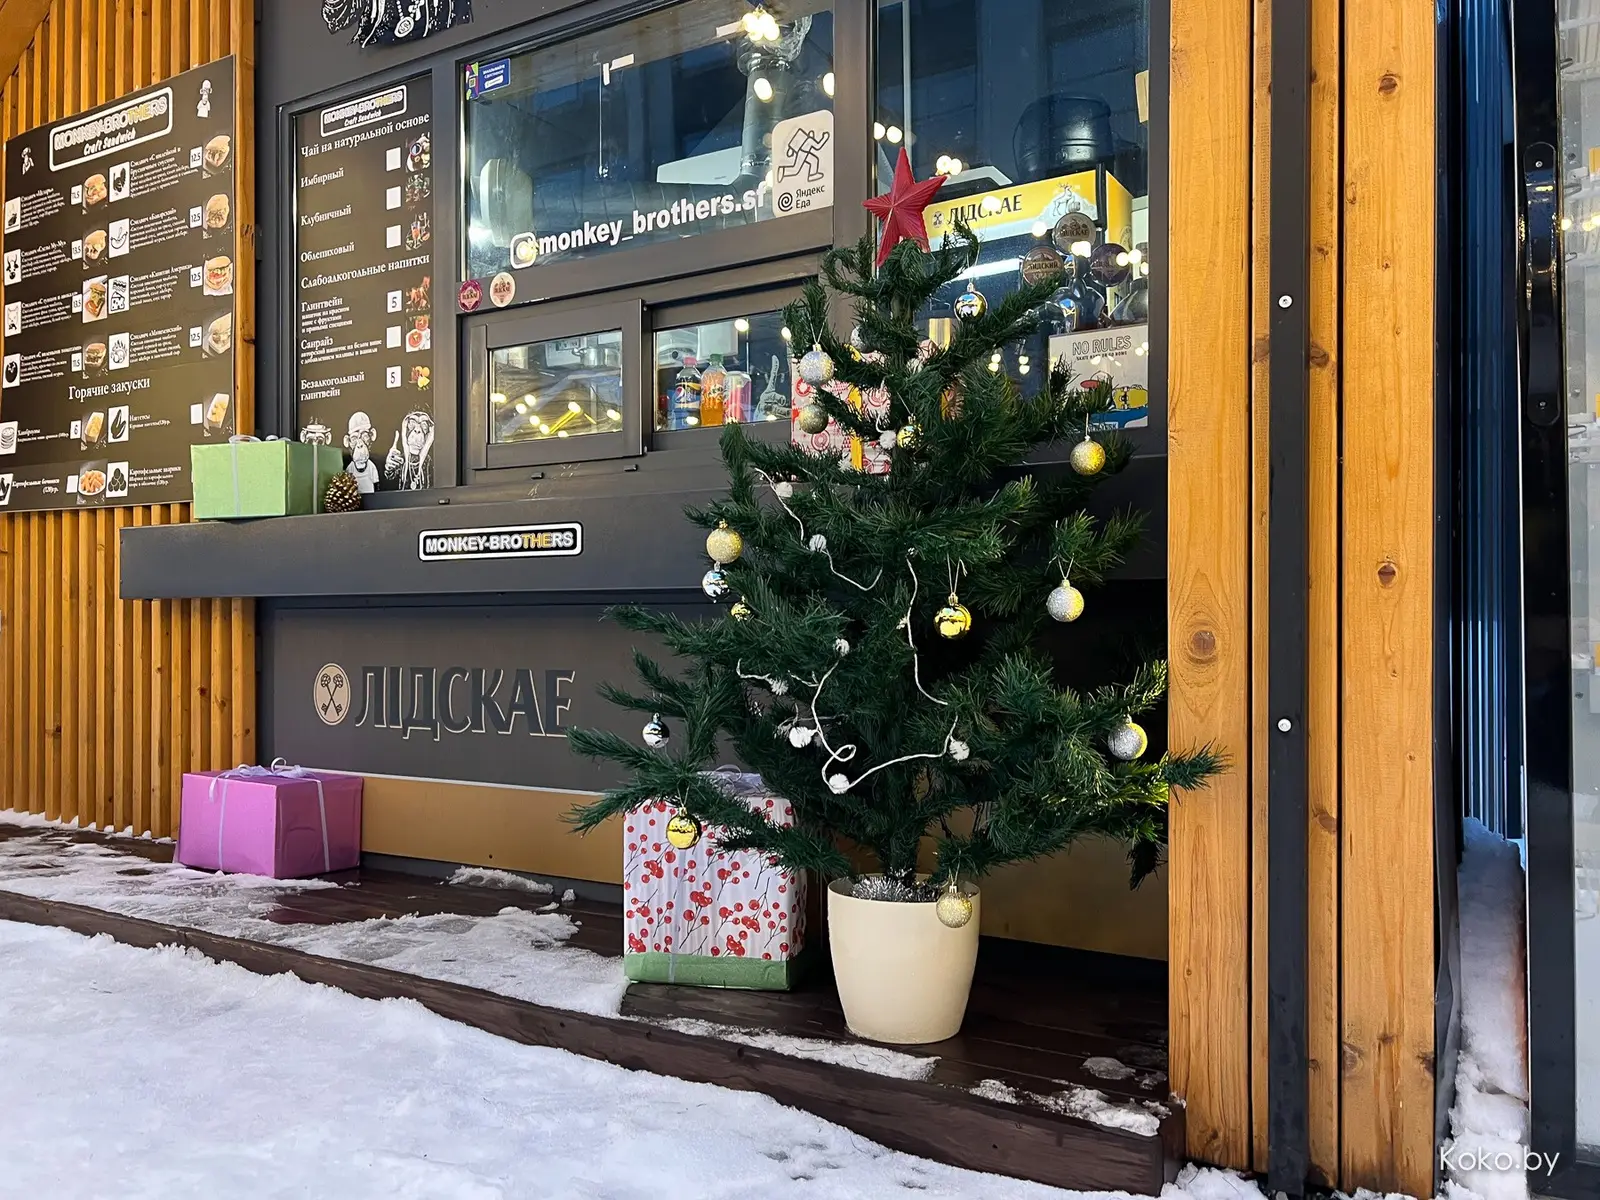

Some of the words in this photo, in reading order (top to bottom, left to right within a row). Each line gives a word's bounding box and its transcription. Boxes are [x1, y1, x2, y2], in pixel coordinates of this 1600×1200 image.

[324, 90, 403, 125] MONKEY-BROTHERS
[54, 96, 168, 151] MONKEY-BROTHERS
[83, 141, 103, 156] Craft
[103, 127, 136, 149] Sandwich
[301, 144, 319, 158] Чай
[321, 141, 332, 151] на
[334, 122, 393, 149] натуральной
[395, 113, 430, 131] основе
[300, 167, 344, 188] Имбирный
[795, 185, 826, 198] Яндекс
[795, 199, 811, 209] Еда
[947, 194, 1022, 224] ЛІДСАЕ
[300, 204, 352, 227] Клубничный
[300, 242, 355, 263] Облепиховый
[301, 264, 386, 289] Слабоалкогольные
[388, 254, 430, 271] напитки
[301, 296, 343, 312] Глинтвейн
[391, 296, 398, 309] 5
[301, 336, 334, 351] Санрайз
[1072, 340, 1090, 356] NO
[1092, 335, 1132, 354] RULES
[301, 371, 365, 390] Безалкогольный
[390, 372, 396, 385] 5
[68, 383, 109, 402] Горячие
[111, 377, 150, 395] закуски
[300, 387, 341, 402] глинтвейн
[425, 531, 574, 553] MONKEY-BROTHERS
[354, 665, 576, 742] ЛІДСКАЕ
